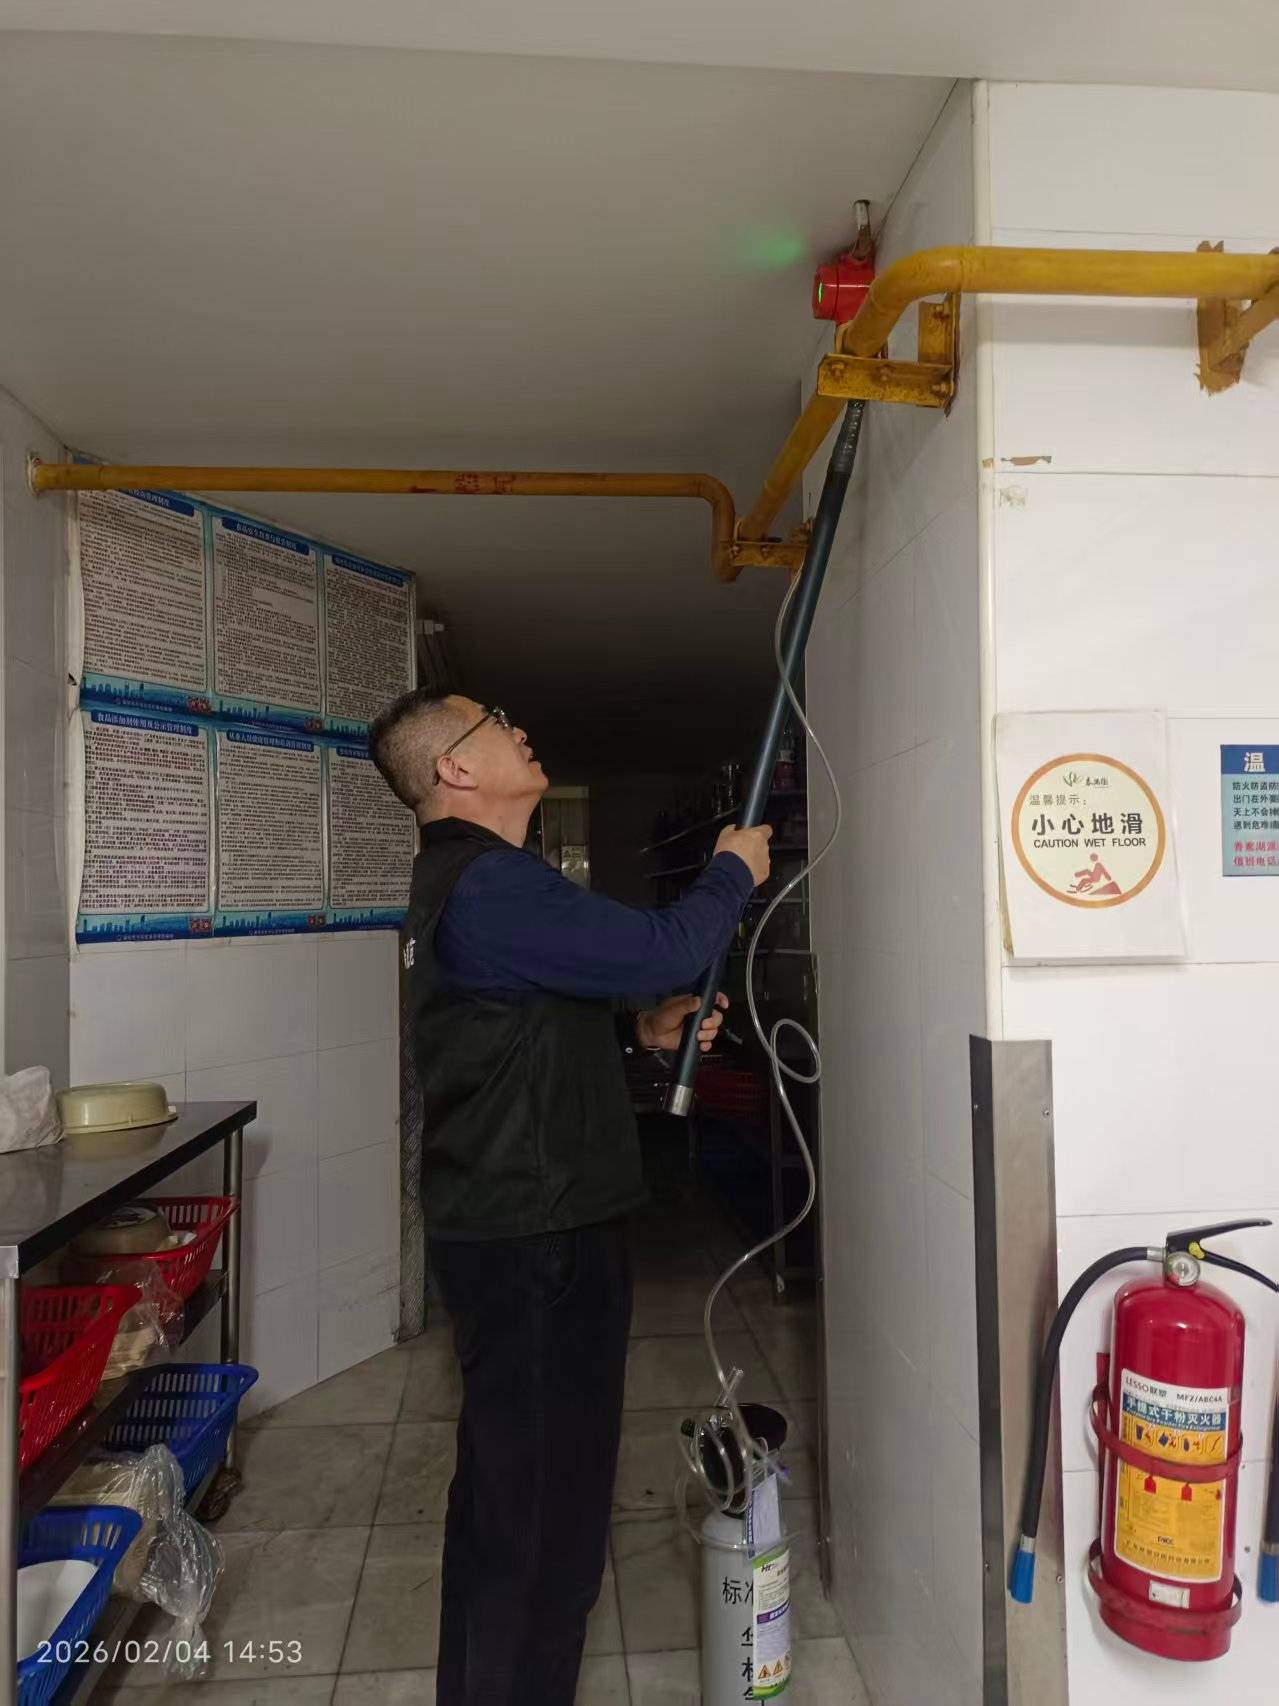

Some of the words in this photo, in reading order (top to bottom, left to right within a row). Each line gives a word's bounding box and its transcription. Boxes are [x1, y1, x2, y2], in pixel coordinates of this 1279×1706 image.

[1244, 752, 1266, 773] 温
[1232, 781, 1279, 791] 防火防盗防
[1031, 813, 1144, 836] 小心地滑
[1033, 838, 1078, 849] CAUTION
[1084, 838, 1106, 848] WET
[1112, 838, 1146, 848] FLOOR
[1127, 1396, 1221, 1426] 手提式干粉灭火器
